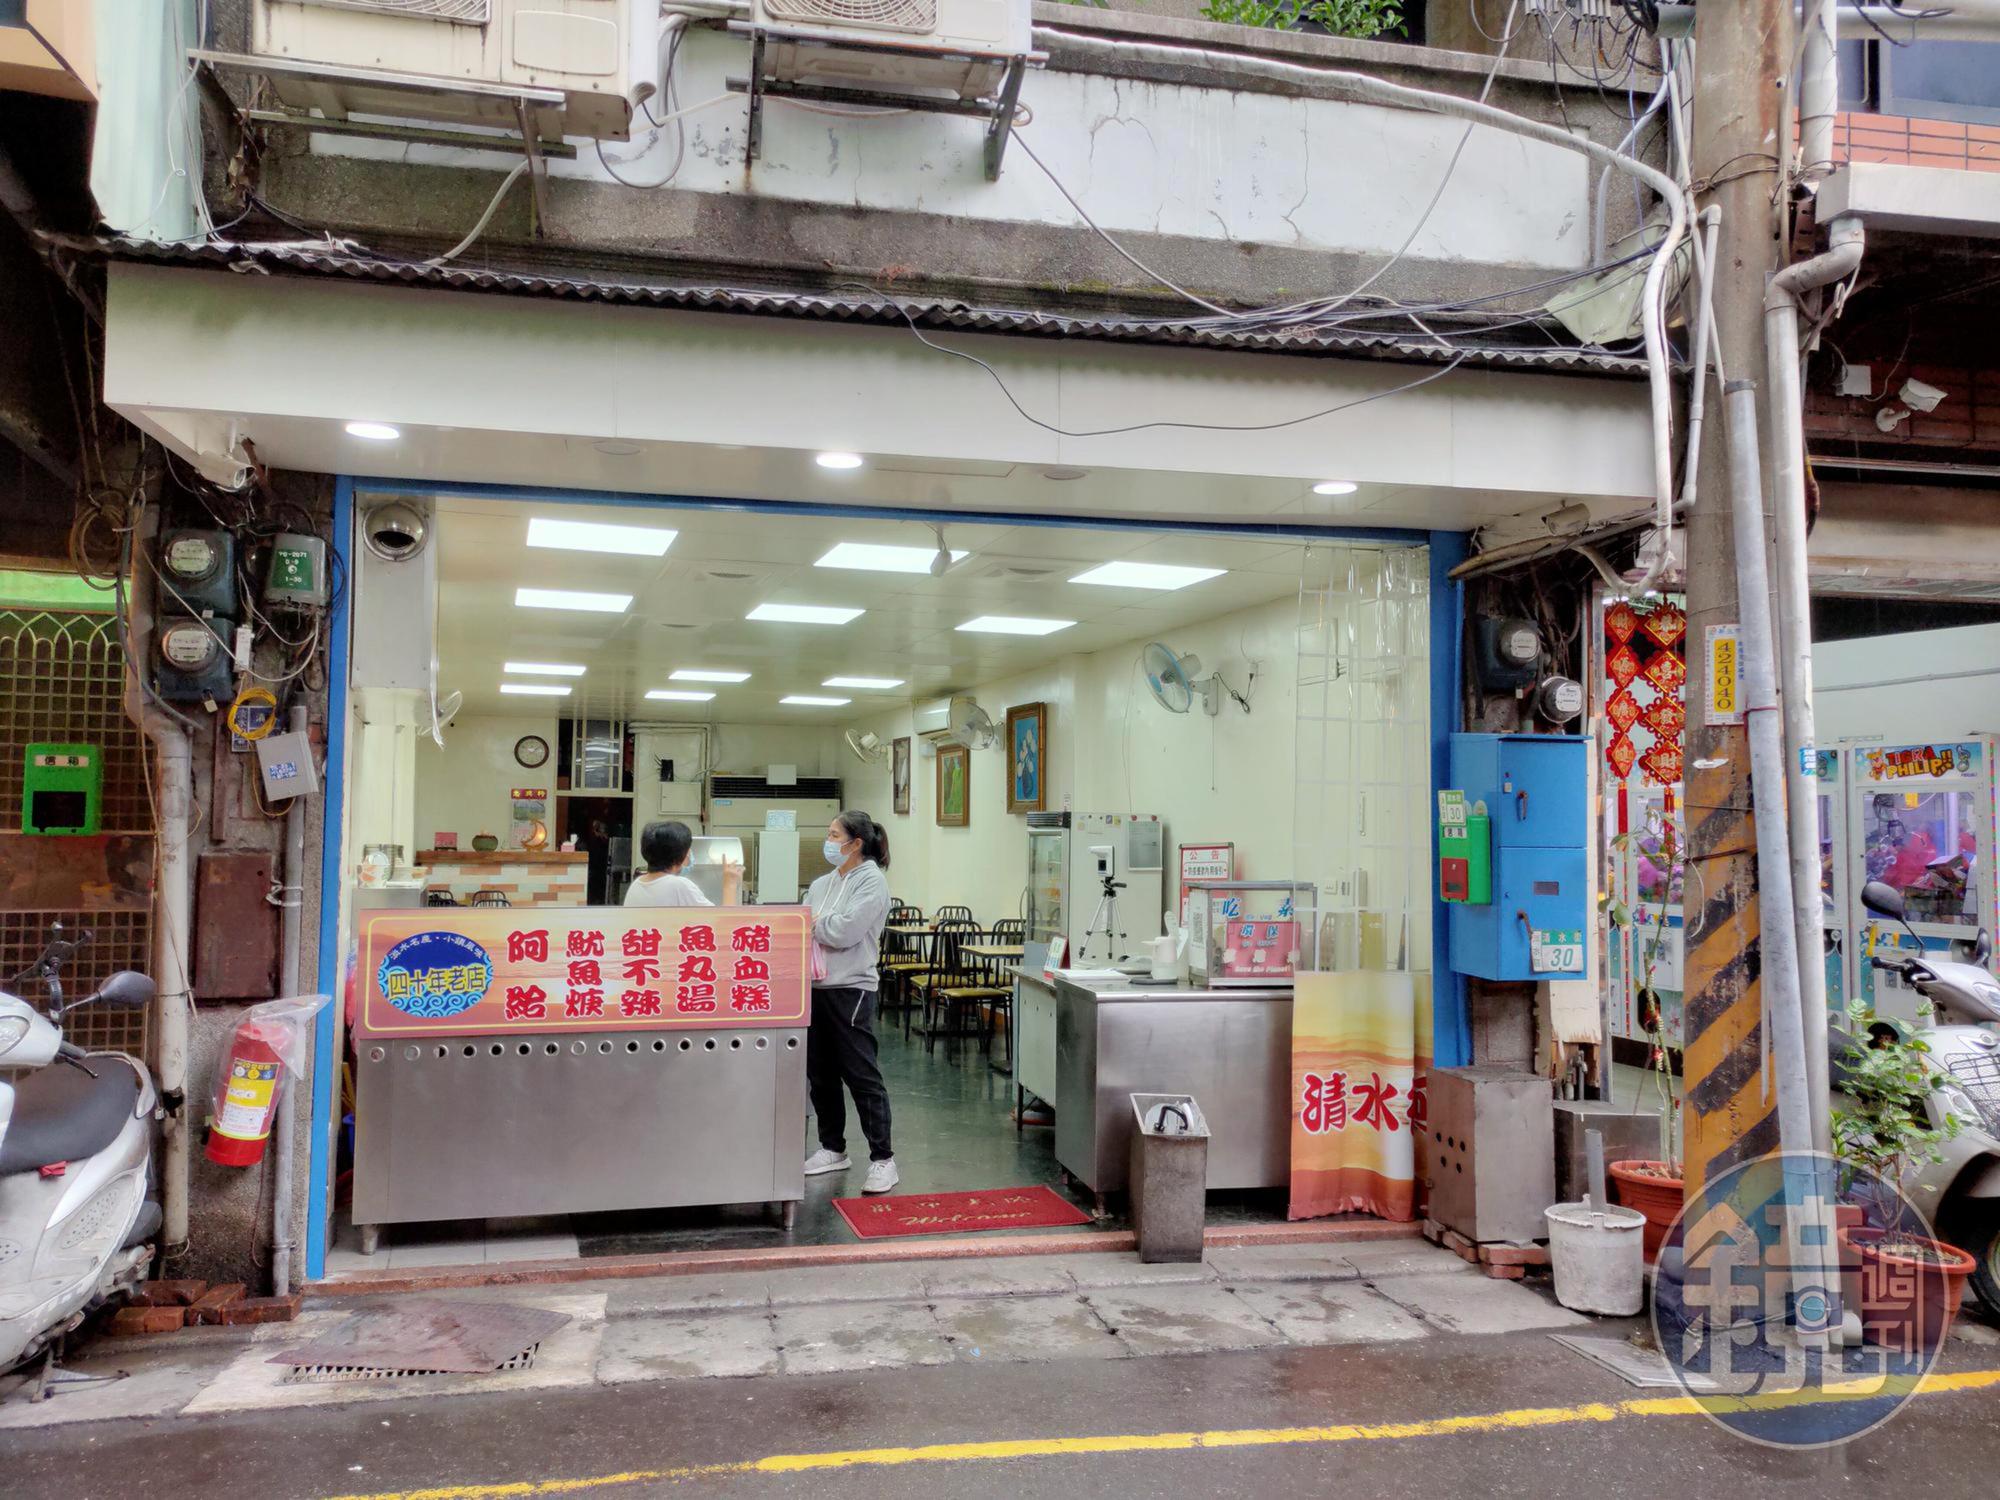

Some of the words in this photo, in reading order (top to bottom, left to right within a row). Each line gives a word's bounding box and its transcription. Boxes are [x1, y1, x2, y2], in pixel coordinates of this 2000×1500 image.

[1717, 642, 1732, 709] 424040
[1450, 807, 1461, 820] 30
[389, 966, 484, 997] 四十年老店
[506, 929, 549, 1019] 阿給
[621, 928, 662, 1016] 甜不辣
[677, 925, 717, 1012] 魚丸湯
[731, 925, 770, 1011] 豬血糕
[1551, 948, 1574, 967] 30
